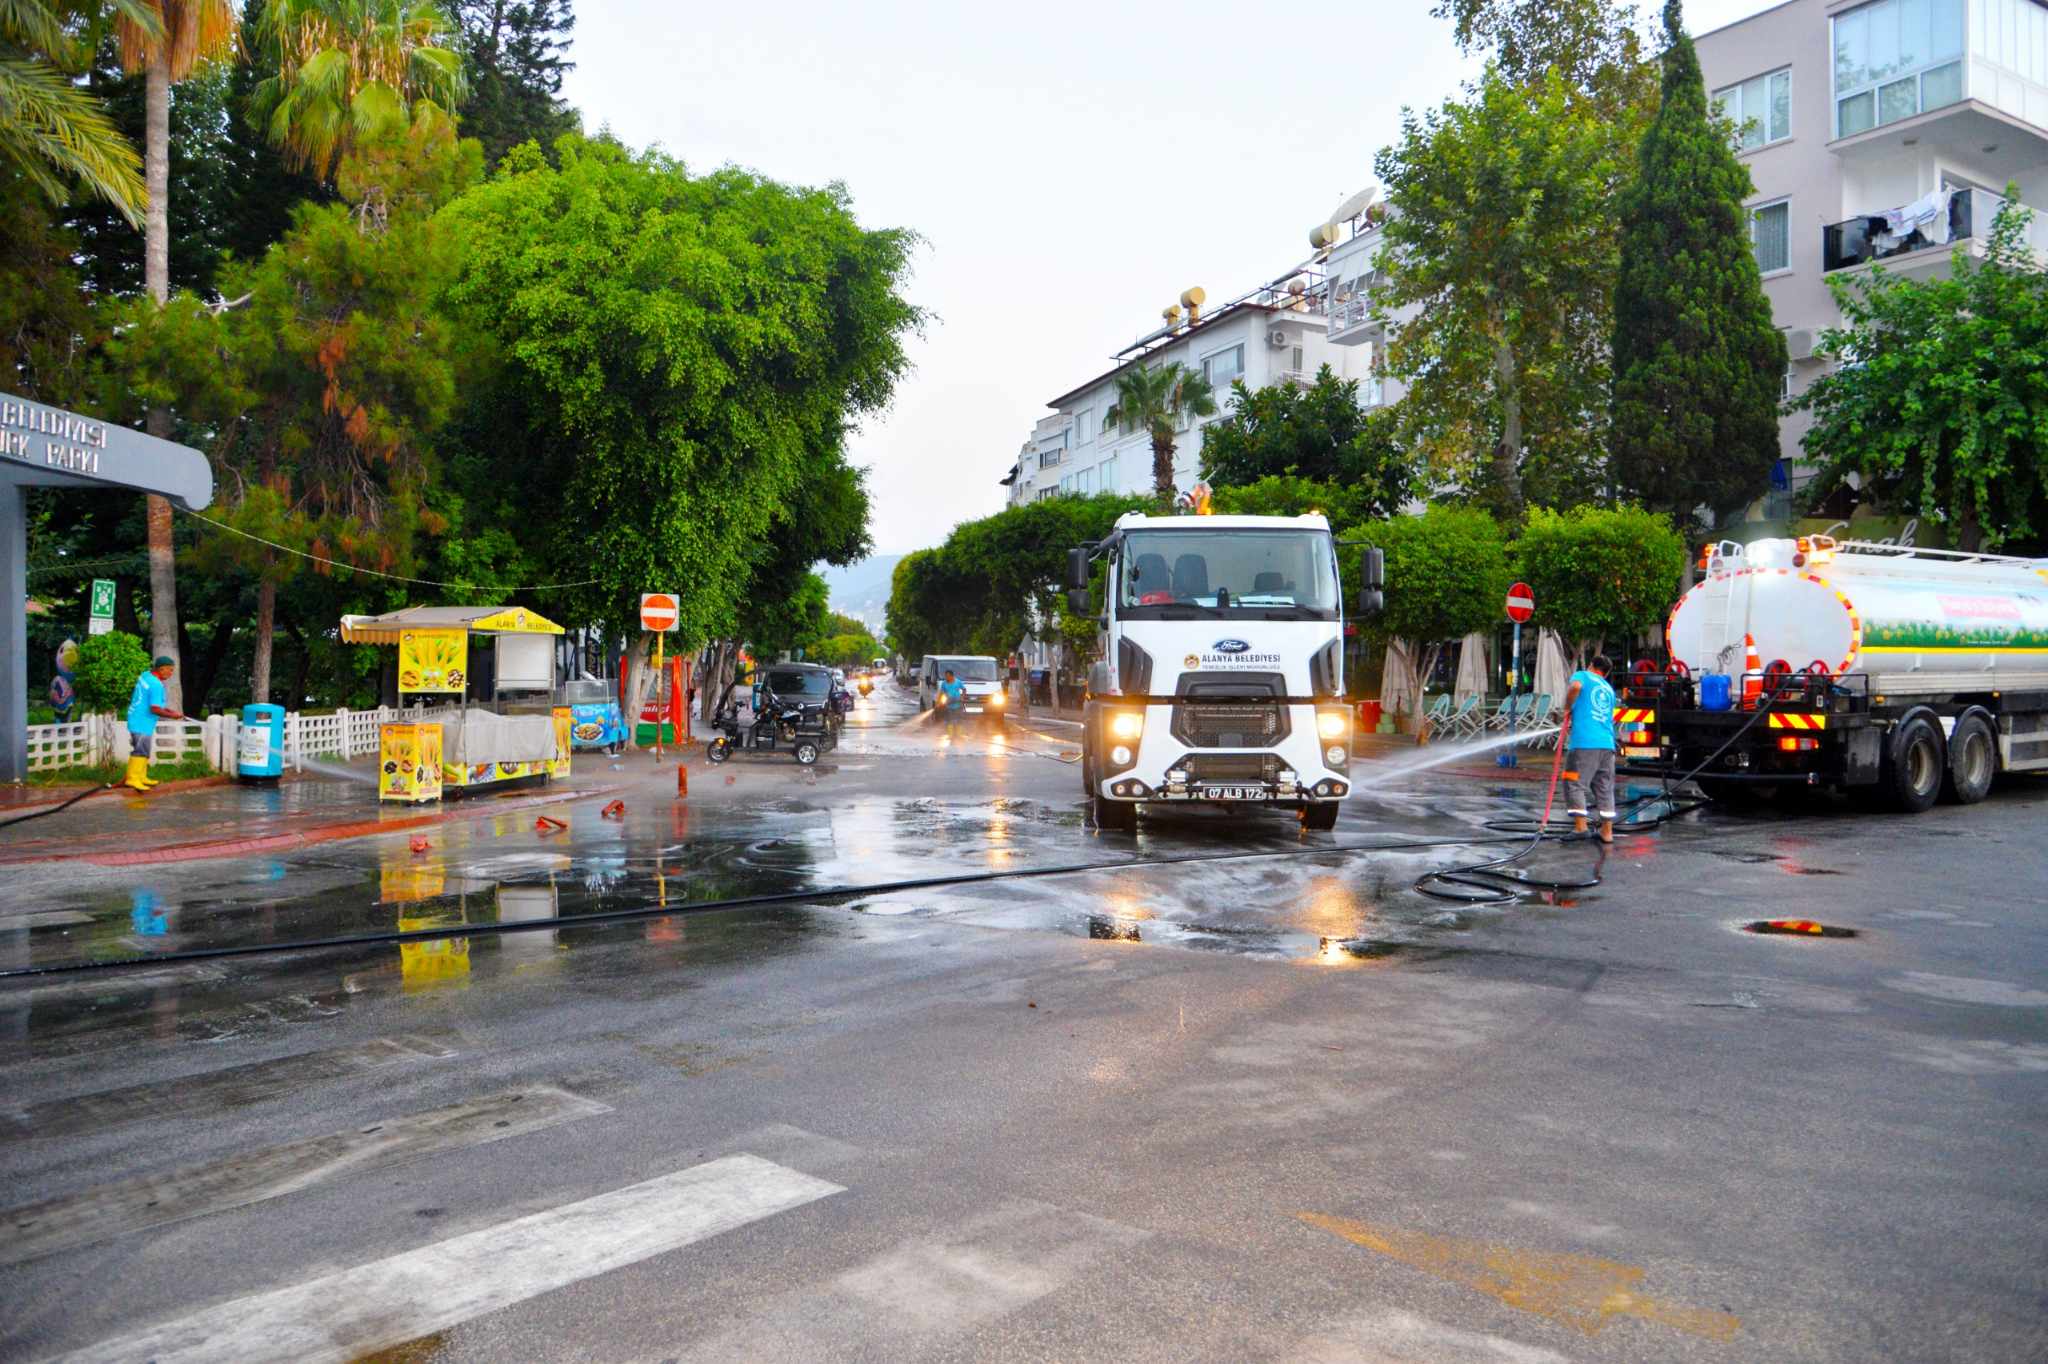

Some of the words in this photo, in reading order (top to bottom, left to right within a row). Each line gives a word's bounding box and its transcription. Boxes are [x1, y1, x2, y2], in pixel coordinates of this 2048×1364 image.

[1202, 654, 1232, 663] ALANYA
[1235, 654, 1281, 663] BELEDİYESİ
[1209, 788, 1221, 799] 07
[1223, 788, 1242, 799] ALB
[1245, 788, 1262, 799] 172
